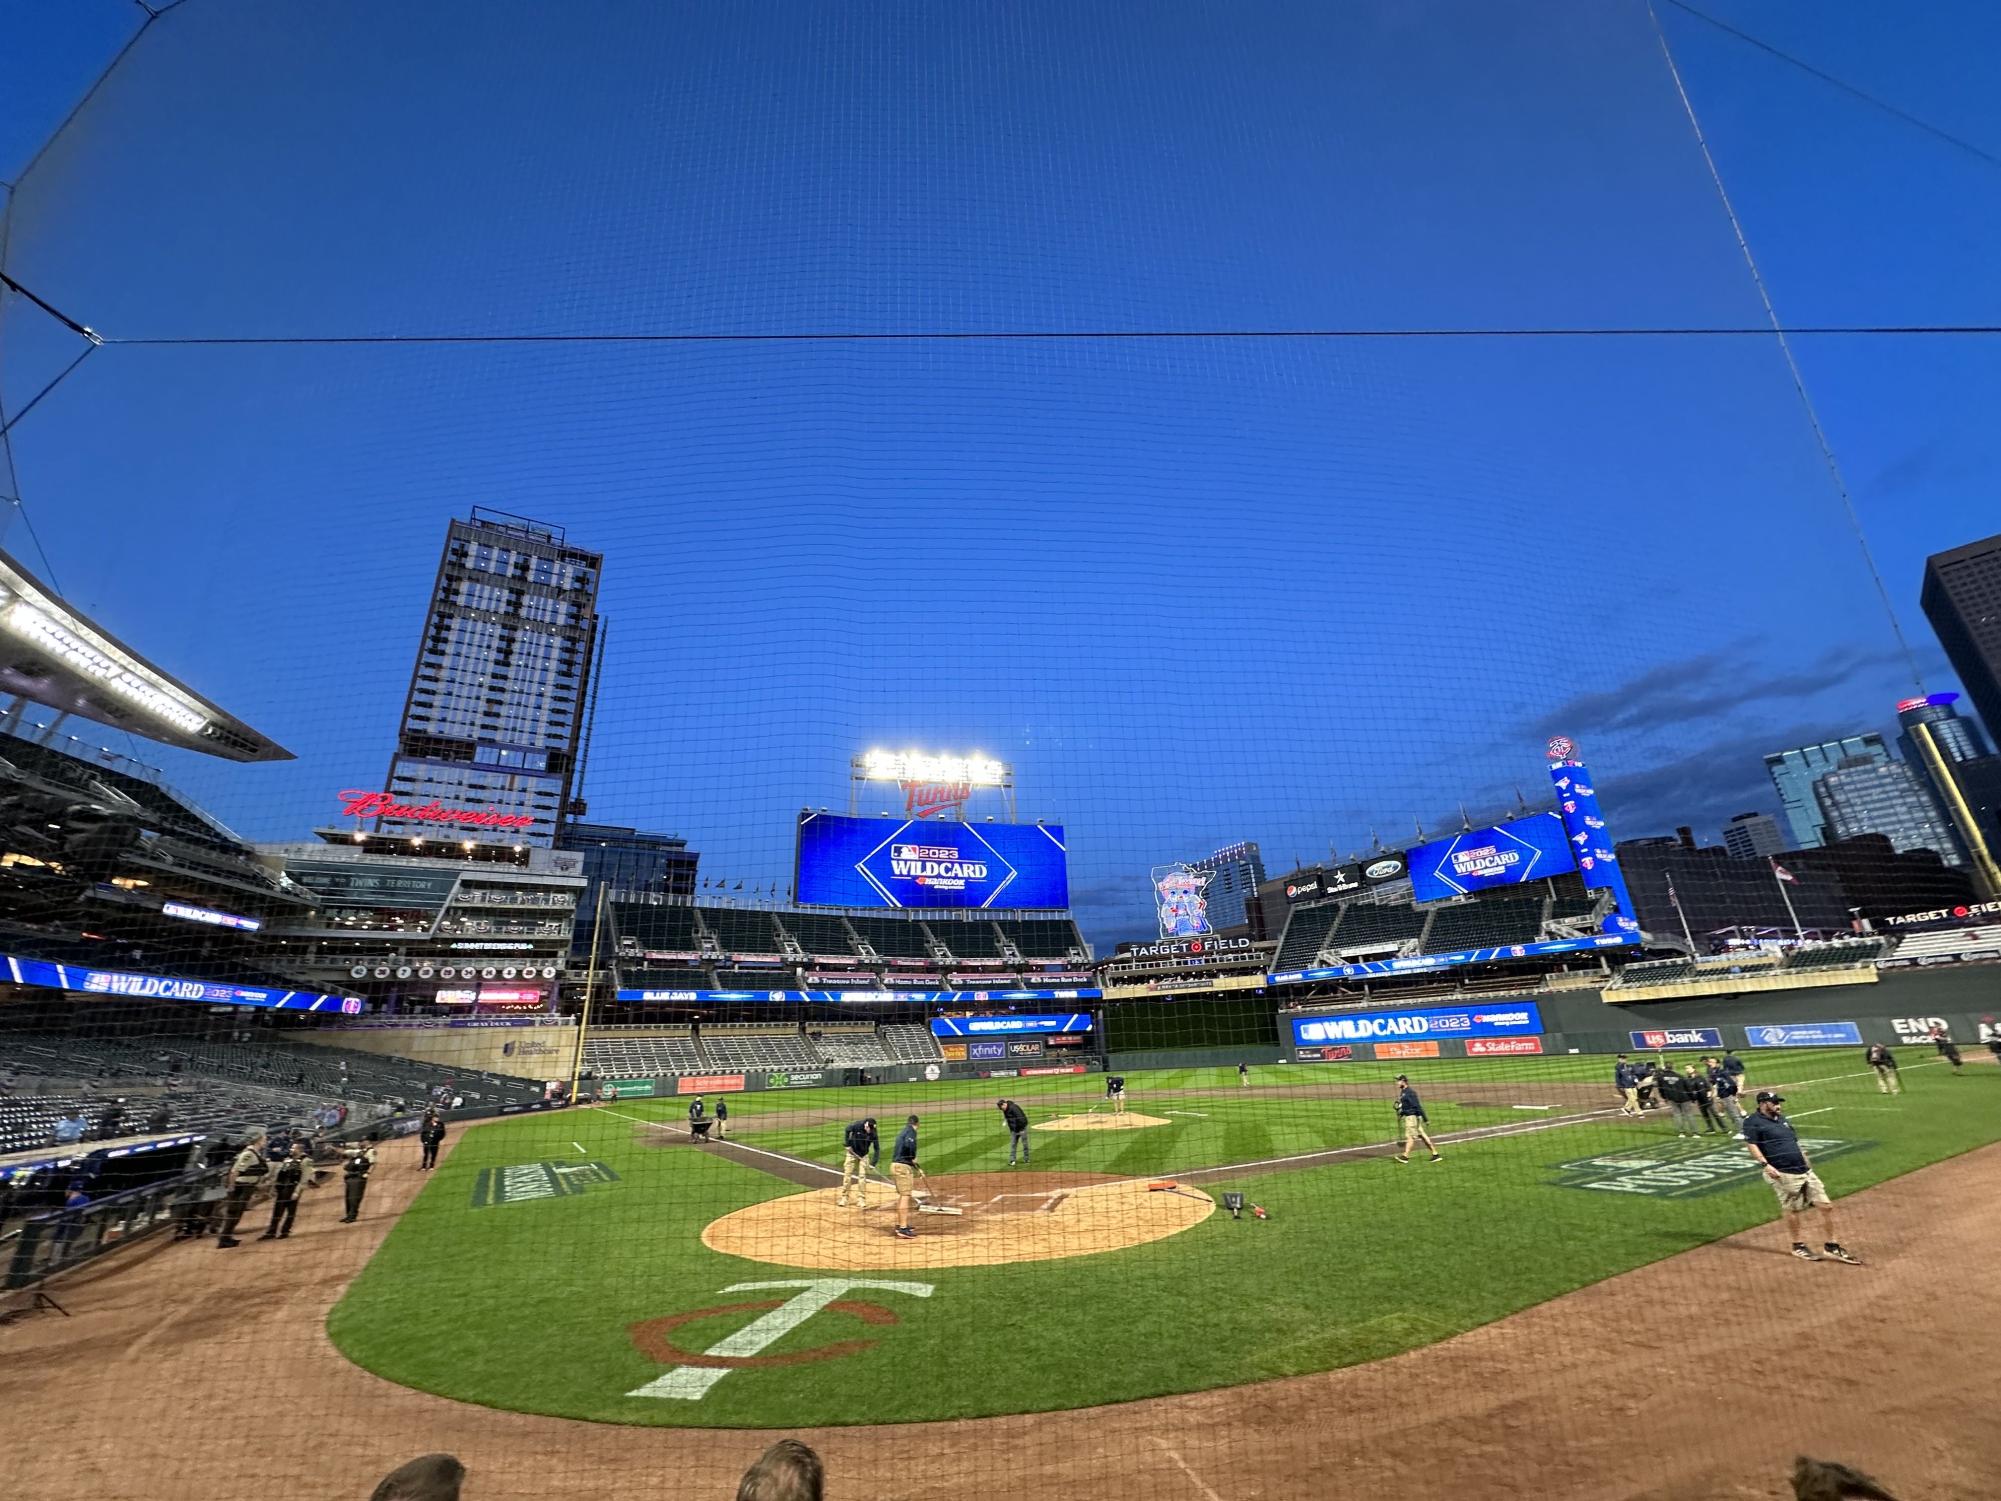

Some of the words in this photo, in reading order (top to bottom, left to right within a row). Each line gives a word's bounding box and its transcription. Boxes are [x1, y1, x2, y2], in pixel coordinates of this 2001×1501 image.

[338, 789, 534, 827] Budweiser
[919, 848, 959, 859] 2023
[1372, 863, 1396, 878] Ford
[386, 879, 433, 889] TERRITORY
[1297, 881, 1318, 894] pepsi
[1885, 909, 1950, 926] TARGET
[1130, 943, 1189, 957] TARGET
[1204, 938, 1250, 951] FIELD
[642, 991, 670, 1000] BLUE
[670, 992, 697, 1000] JAYS
[1430, 1017, 1471, 1029] 2023
[1891, 1017, 1949, 1034] END
[972, 1044, 1004, 1058] xfinity
[790, 1073, 822, 1081] securian
